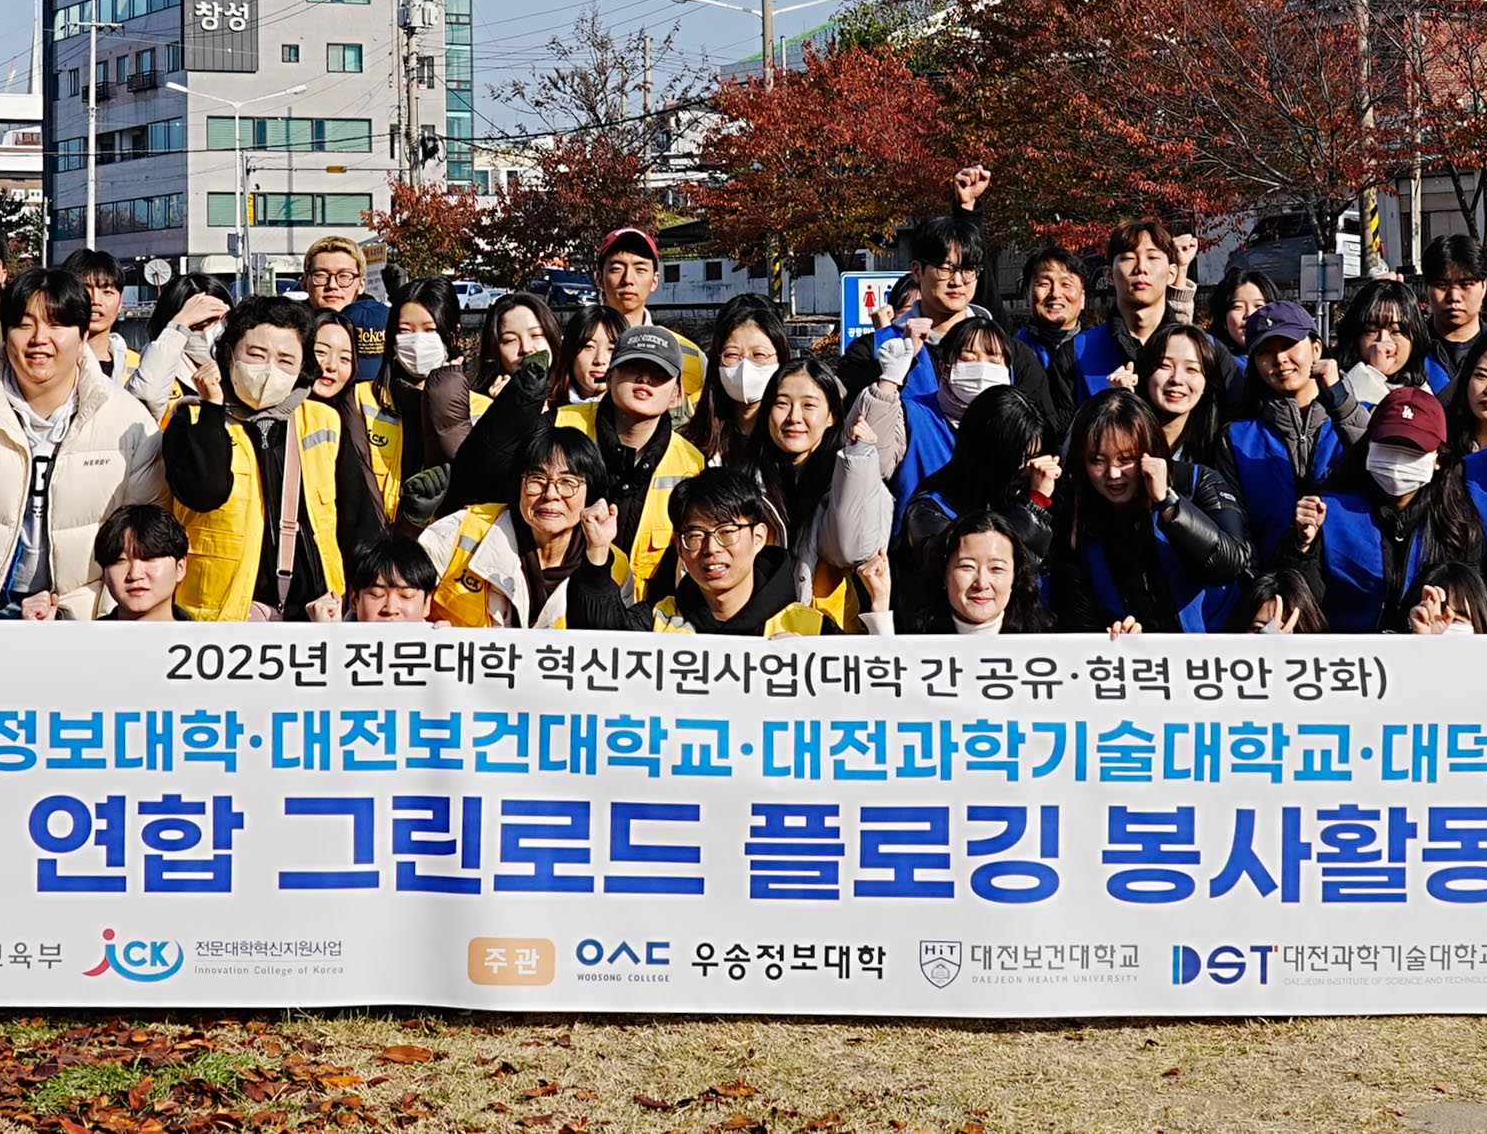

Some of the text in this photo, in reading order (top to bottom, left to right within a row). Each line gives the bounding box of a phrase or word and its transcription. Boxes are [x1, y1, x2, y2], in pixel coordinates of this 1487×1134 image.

[195, 0, 249, 31] 창성
[83, 458, 111, 467] NERDY
[166, 641, 1388, 701] 2025년 전문대학 혁신지원사업(대학 간 공유·협력 방안 강화)
[29, 794, 245, 894] 연합
[279, 796, 705, 896] 그린로드
[745, 803, 1060, 904] 플로깅
[195, 940, 343, 957] 전문대학혁신지원사업
[971, 944, 1140, 971] 대전보건대학교
[194, 965, 344, 977] Innovation College of Korea
[483, 947, 541, 976] 주관
[691, 942, 887, 980] 우송정보대학
[577, 973, 669, 983] WOOSONG COLLEGE
[971, 974, 1139, 984] DAEJEON HEALTH UNIVERSITY
[1327, 976, 1369, 986] INSTITUTE
[1386, 976, 1422, 986] SCIENCE
[1425, 976, 1442, 985] AND
